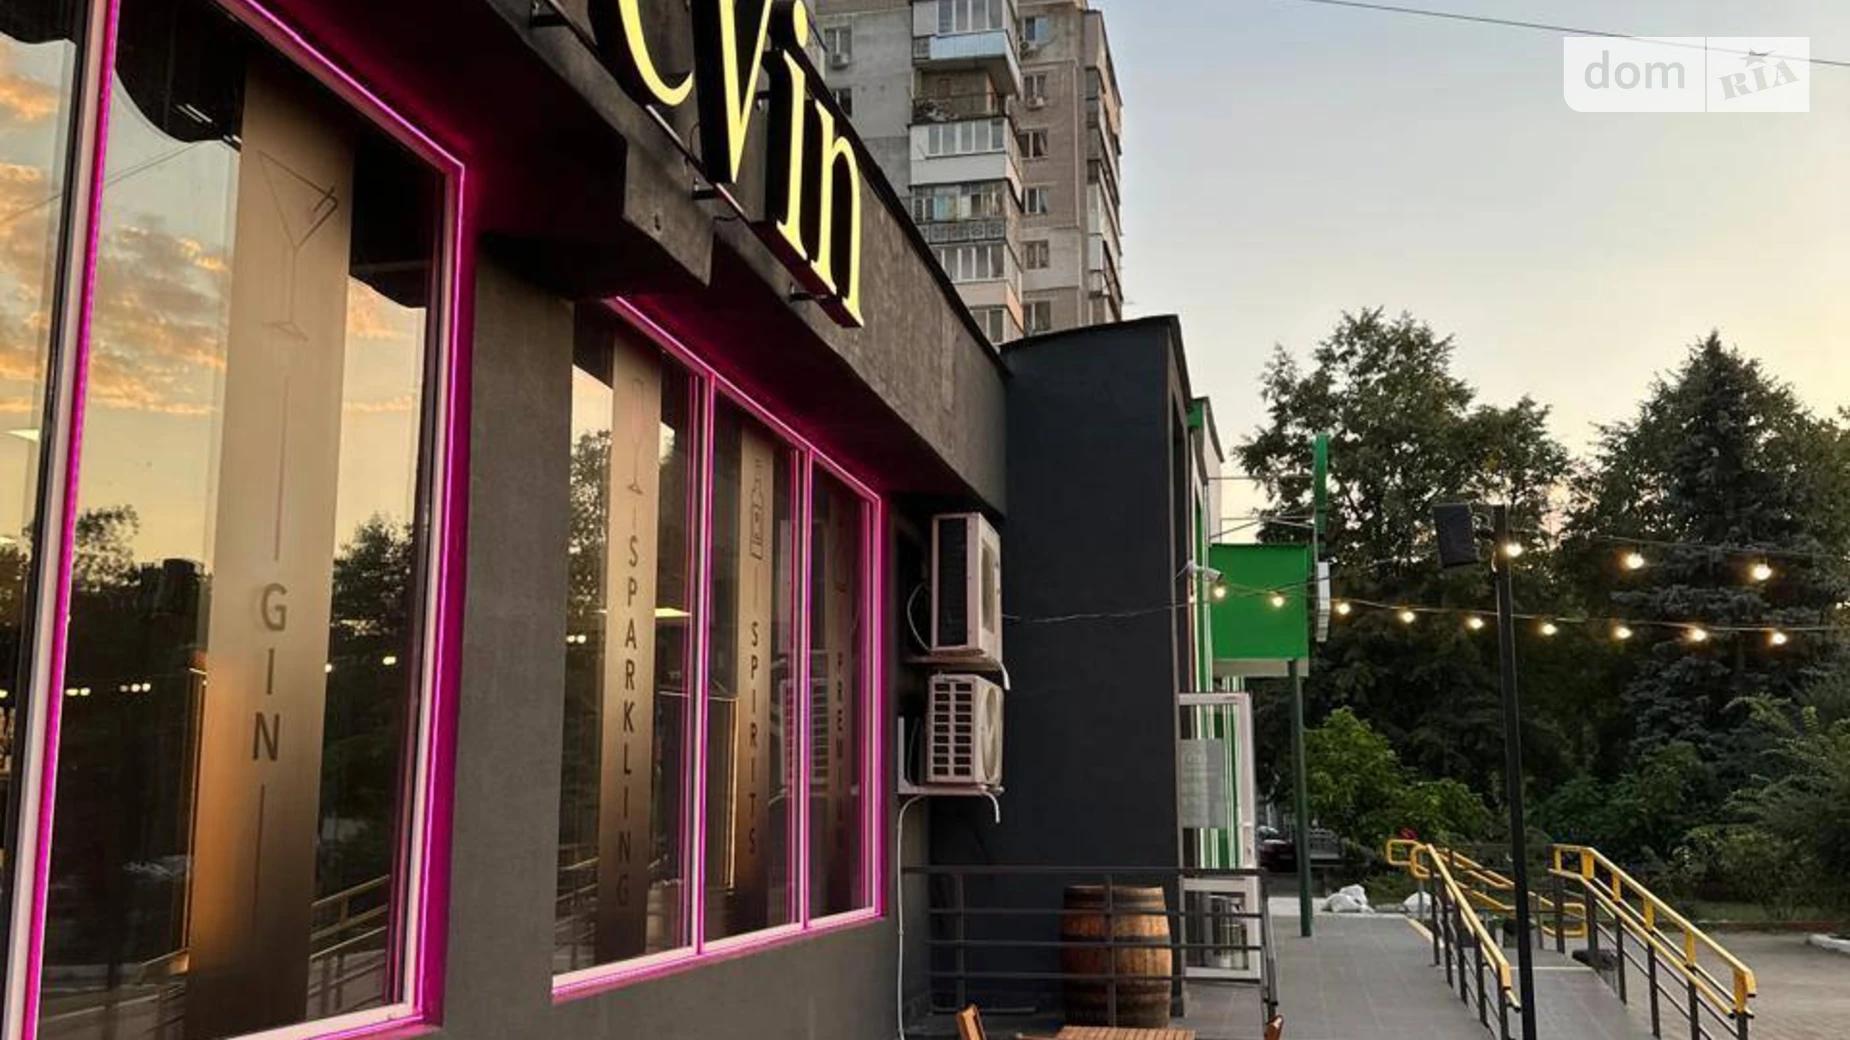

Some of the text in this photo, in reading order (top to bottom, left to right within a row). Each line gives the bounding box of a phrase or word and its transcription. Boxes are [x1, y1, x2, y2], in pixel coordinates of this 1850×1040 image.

[252, 582, 288, 761] GIN
[616, 536, 639, 906] SPARKLING
[747, 621, 759, 855] SPIRITS
